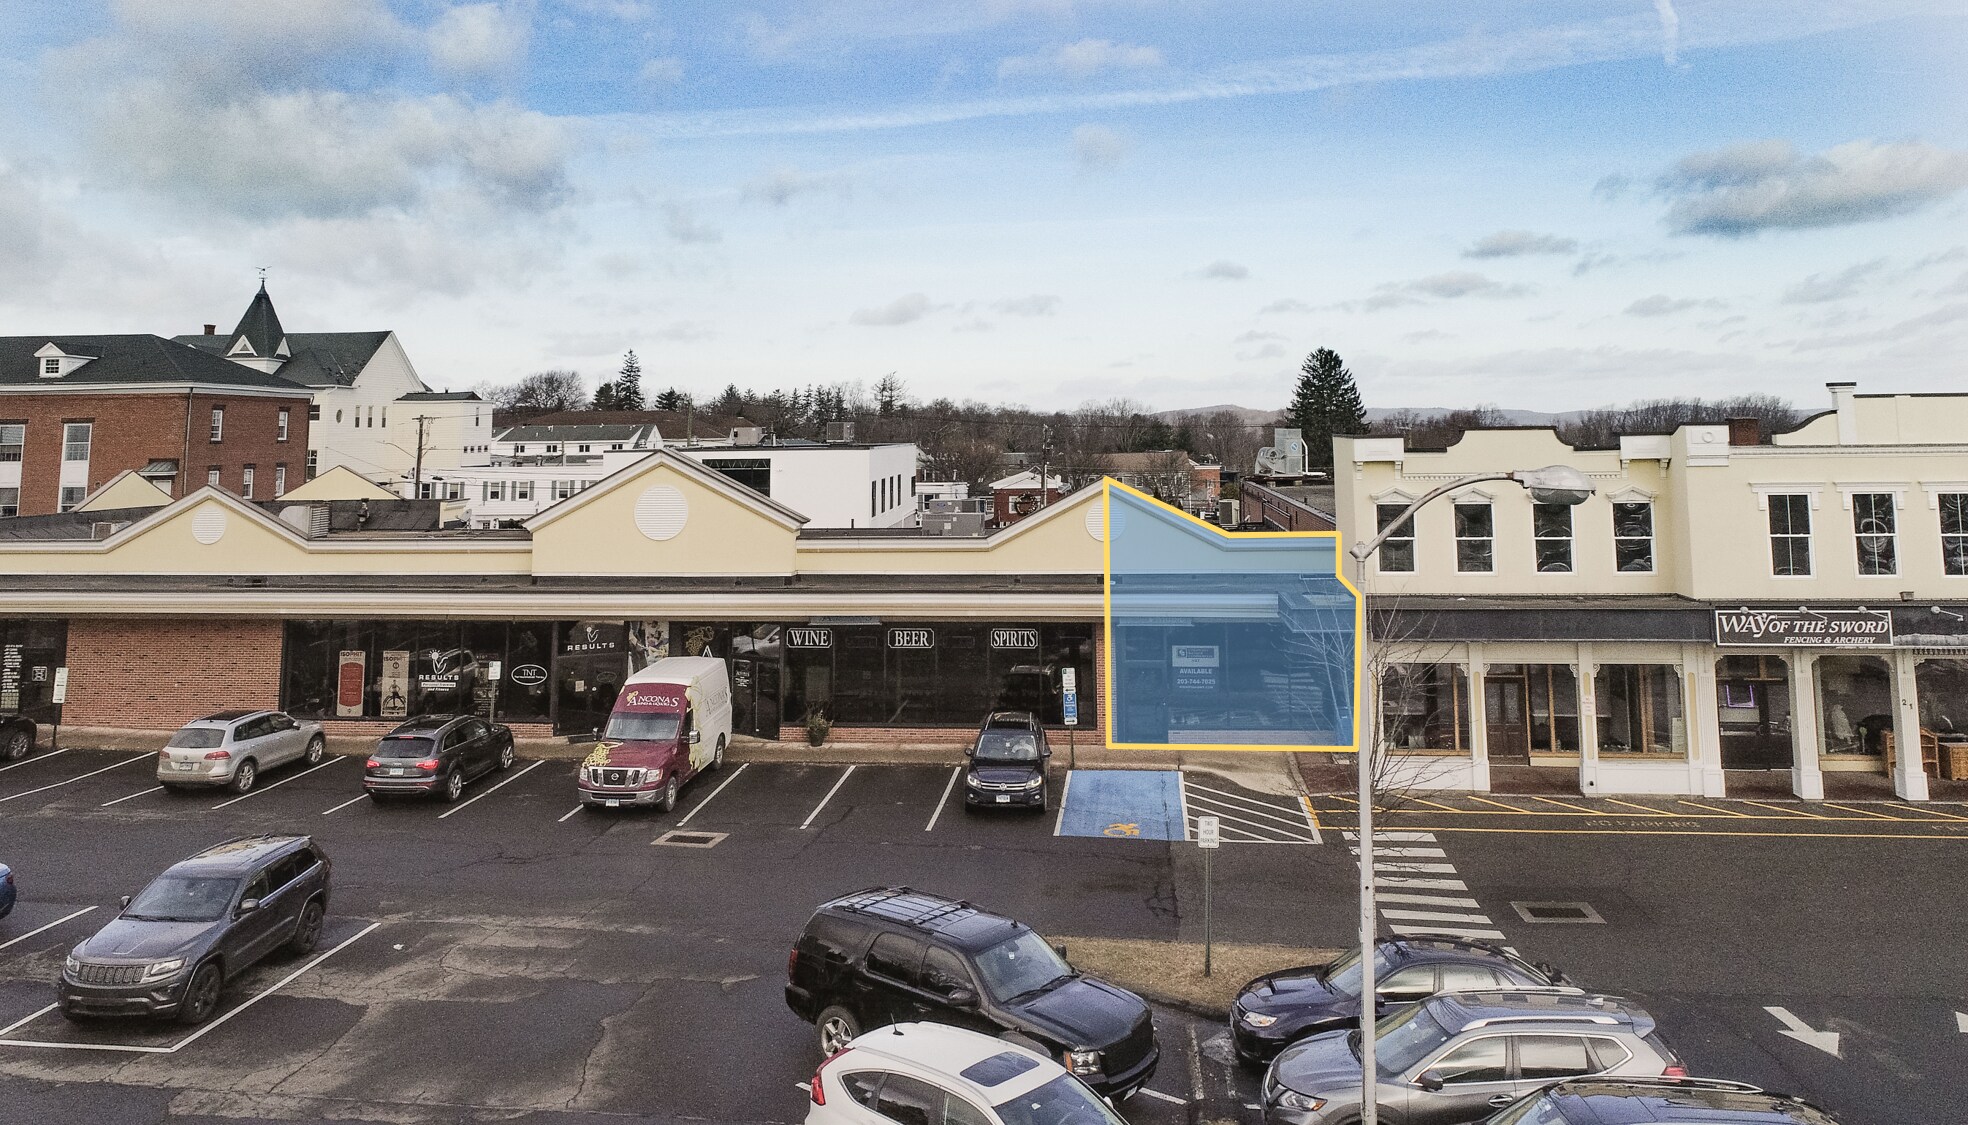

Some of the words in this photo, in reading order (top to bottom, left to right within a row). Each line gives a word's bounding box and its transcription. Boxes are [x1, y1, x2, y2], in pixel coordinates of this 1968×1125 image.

[1719, 613, 1776, 637] WAY
[1769, 621, 1790, 633] OF
[1794, 621, 1826, 633] THE
[1829, 620, 1888, 634] SWORD
[790, 630, 829, 646] WINE
[894, 630, 930, 647] BEER
[993, 630, 1036, 647] SPIRITS
[1784, 636, 1822, 644] FENCING
[1833, 636, 1876, 644] ARCHERY
[567, 642, 615, 652] RESULTS
[522, 668, 537, 676] TNT
